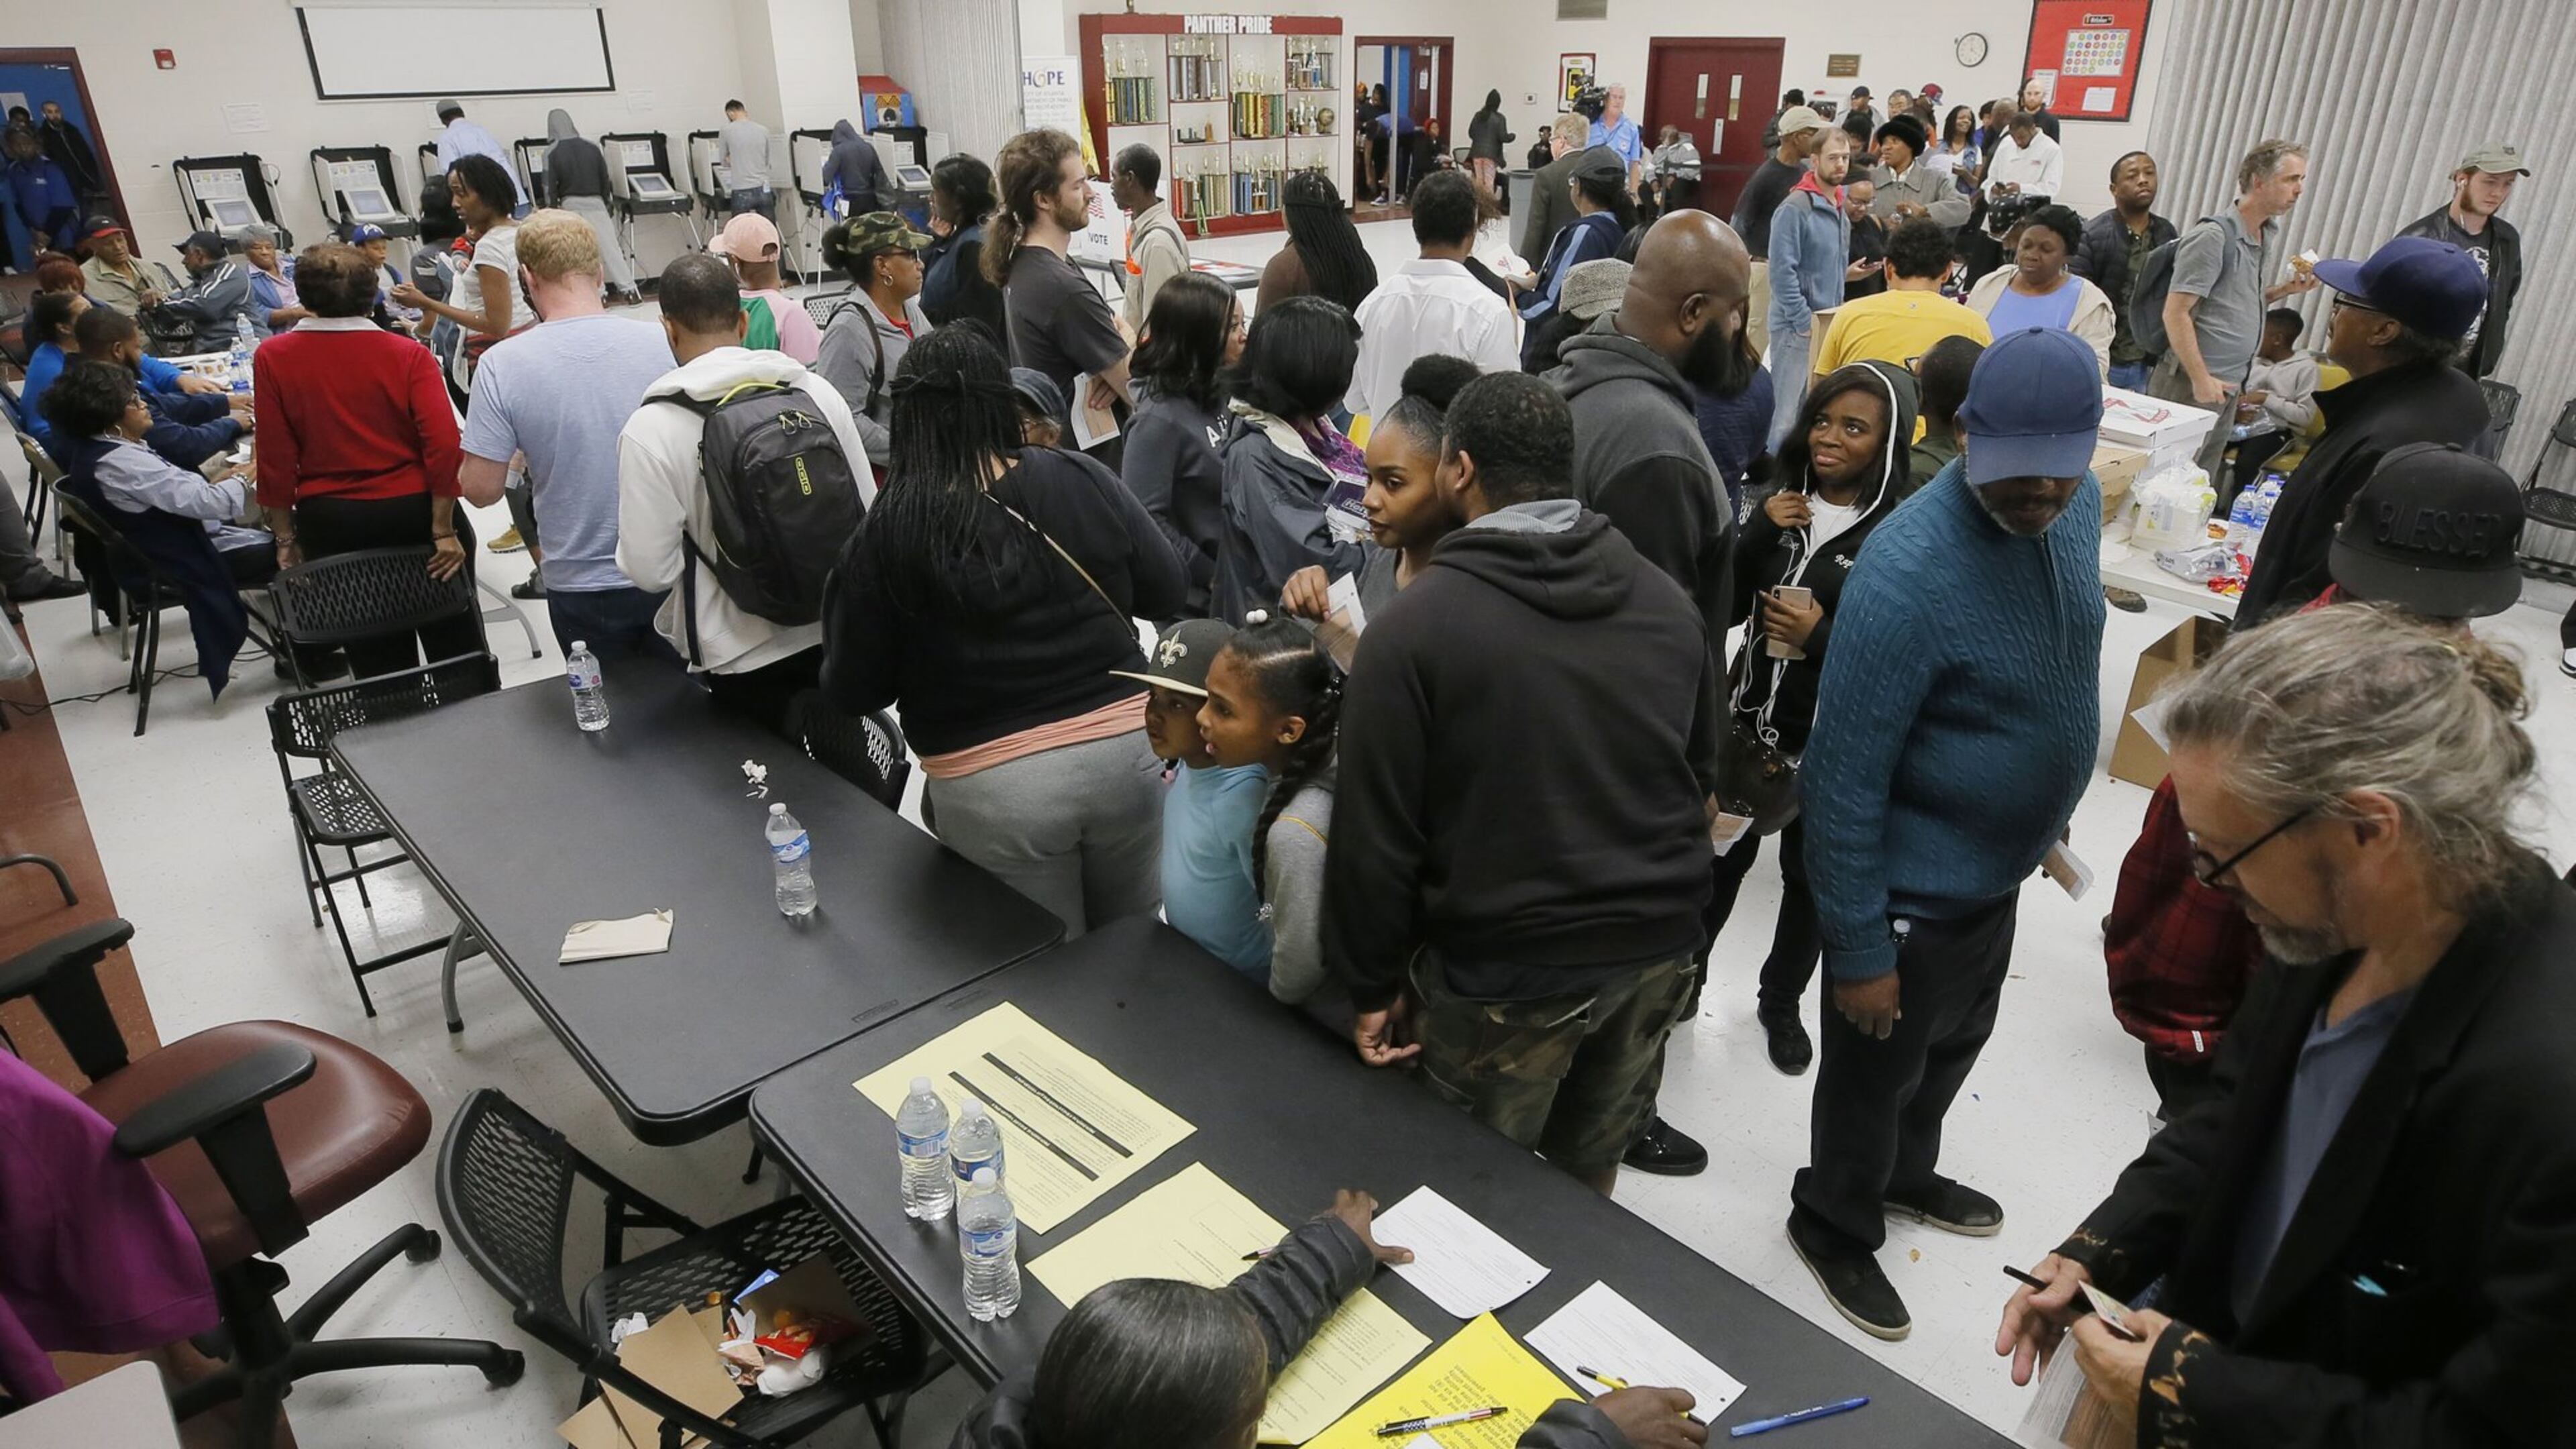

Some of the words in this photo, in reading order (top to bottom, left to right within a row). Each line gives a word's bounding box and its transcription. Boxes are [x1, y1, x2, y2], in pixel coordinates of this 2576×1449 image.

[1184, 15, 1236, 34] PANTHER
[1238, 15, 1273, 34] PRIDE
[1022, 68, 1065, 88] HOPE
[1088, 232, 1109, 246] VOTE
[2378, 500, 2502, 559] BLESSED
